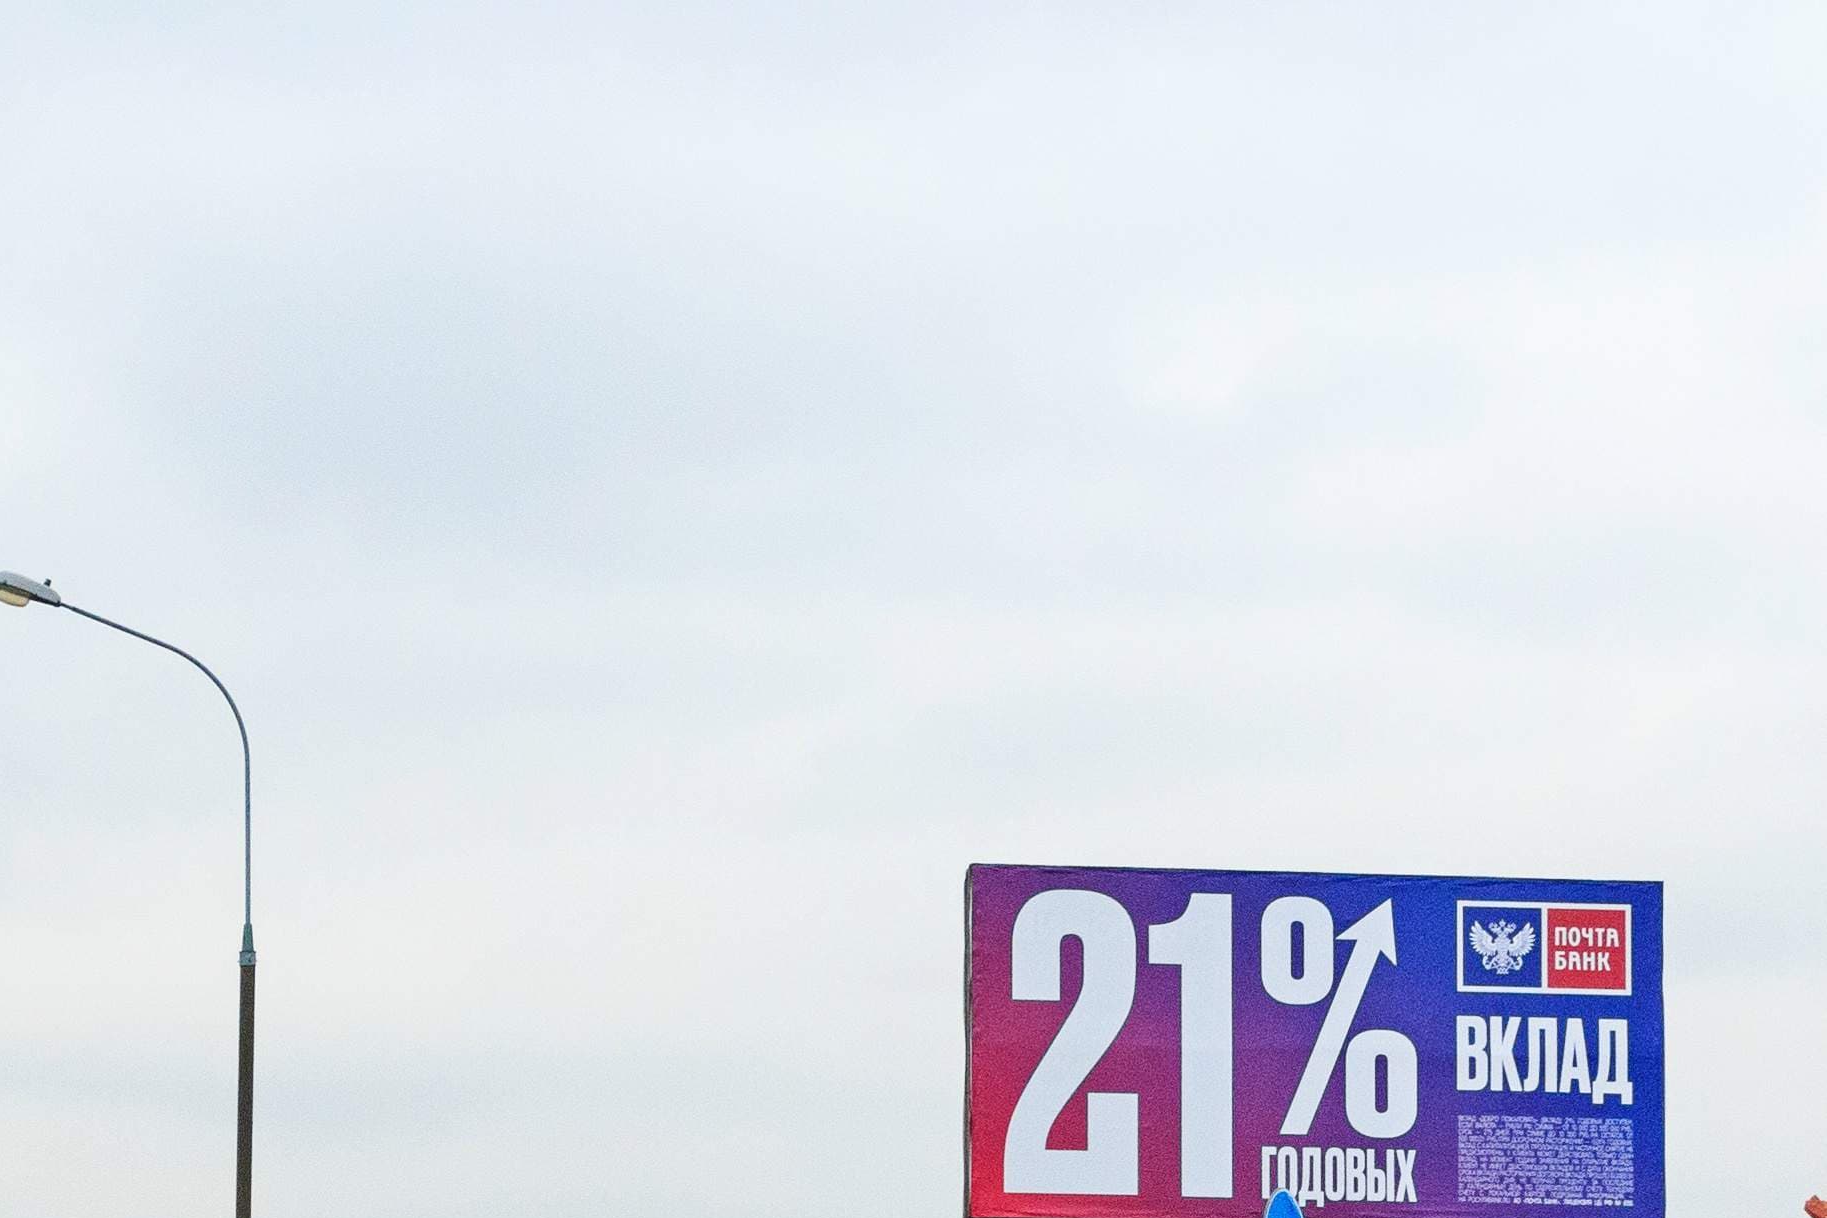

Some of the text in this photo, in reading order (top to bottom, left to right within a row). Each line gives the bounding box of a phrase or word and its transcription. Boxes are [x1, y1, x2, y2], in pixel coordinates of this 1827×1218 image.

[1554, 926, 1620, 948] ПОЧТА
[1554, 950, 1611, 972] БАНК
[1003, 888, 1418, 1198] 21%
[1456, 1014, 1633, 1105] ВКЛАД
[1261, 1146, 1418, 1208] ГОДОВЫХ
